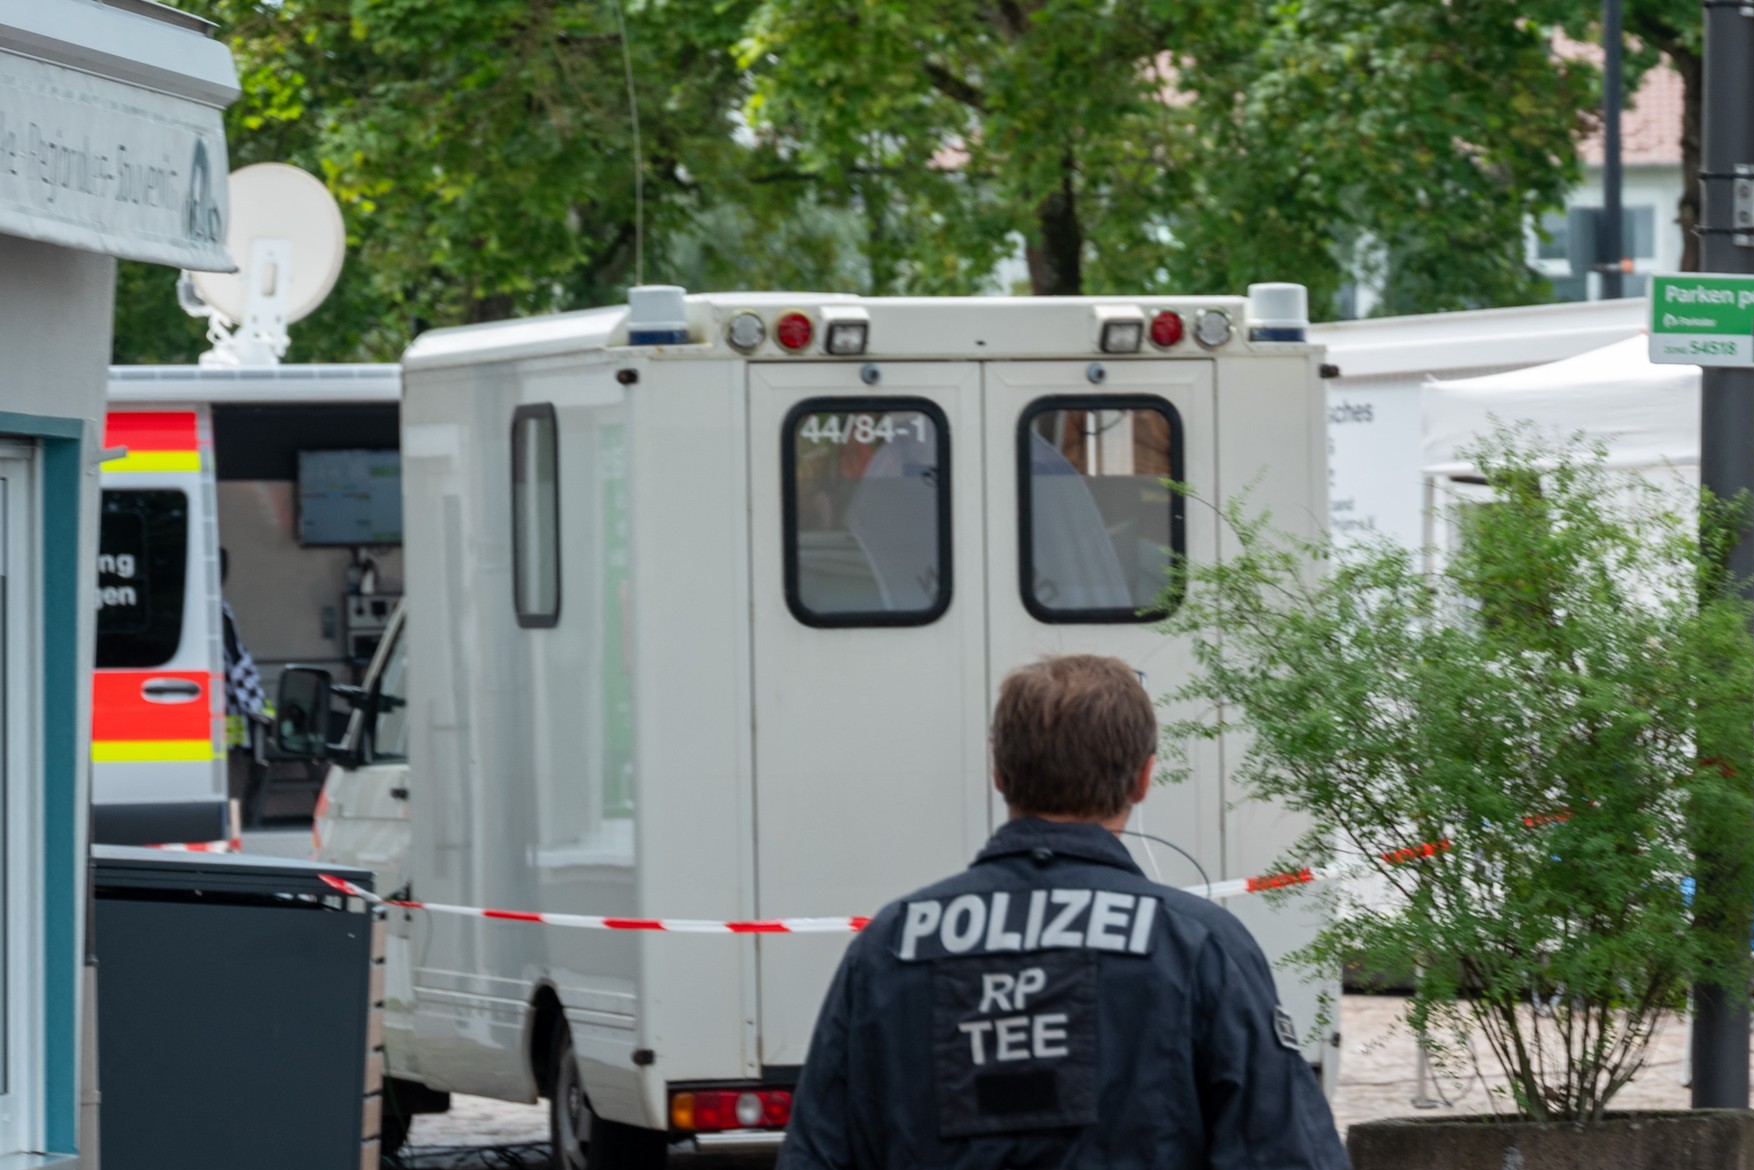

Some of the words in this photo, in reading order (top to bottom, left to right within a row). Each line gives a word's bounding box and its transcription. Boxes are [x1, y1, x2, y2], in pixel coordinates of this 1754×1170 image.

[1665, 284, 1735, 304] Parken
[801, 414, 926, 444] 44/84-1
[898, 889, 1159, 961] POLIZEI
[978, 967, 1047, 1014] RP
[958, 1013, 1070, 1066] TEE
